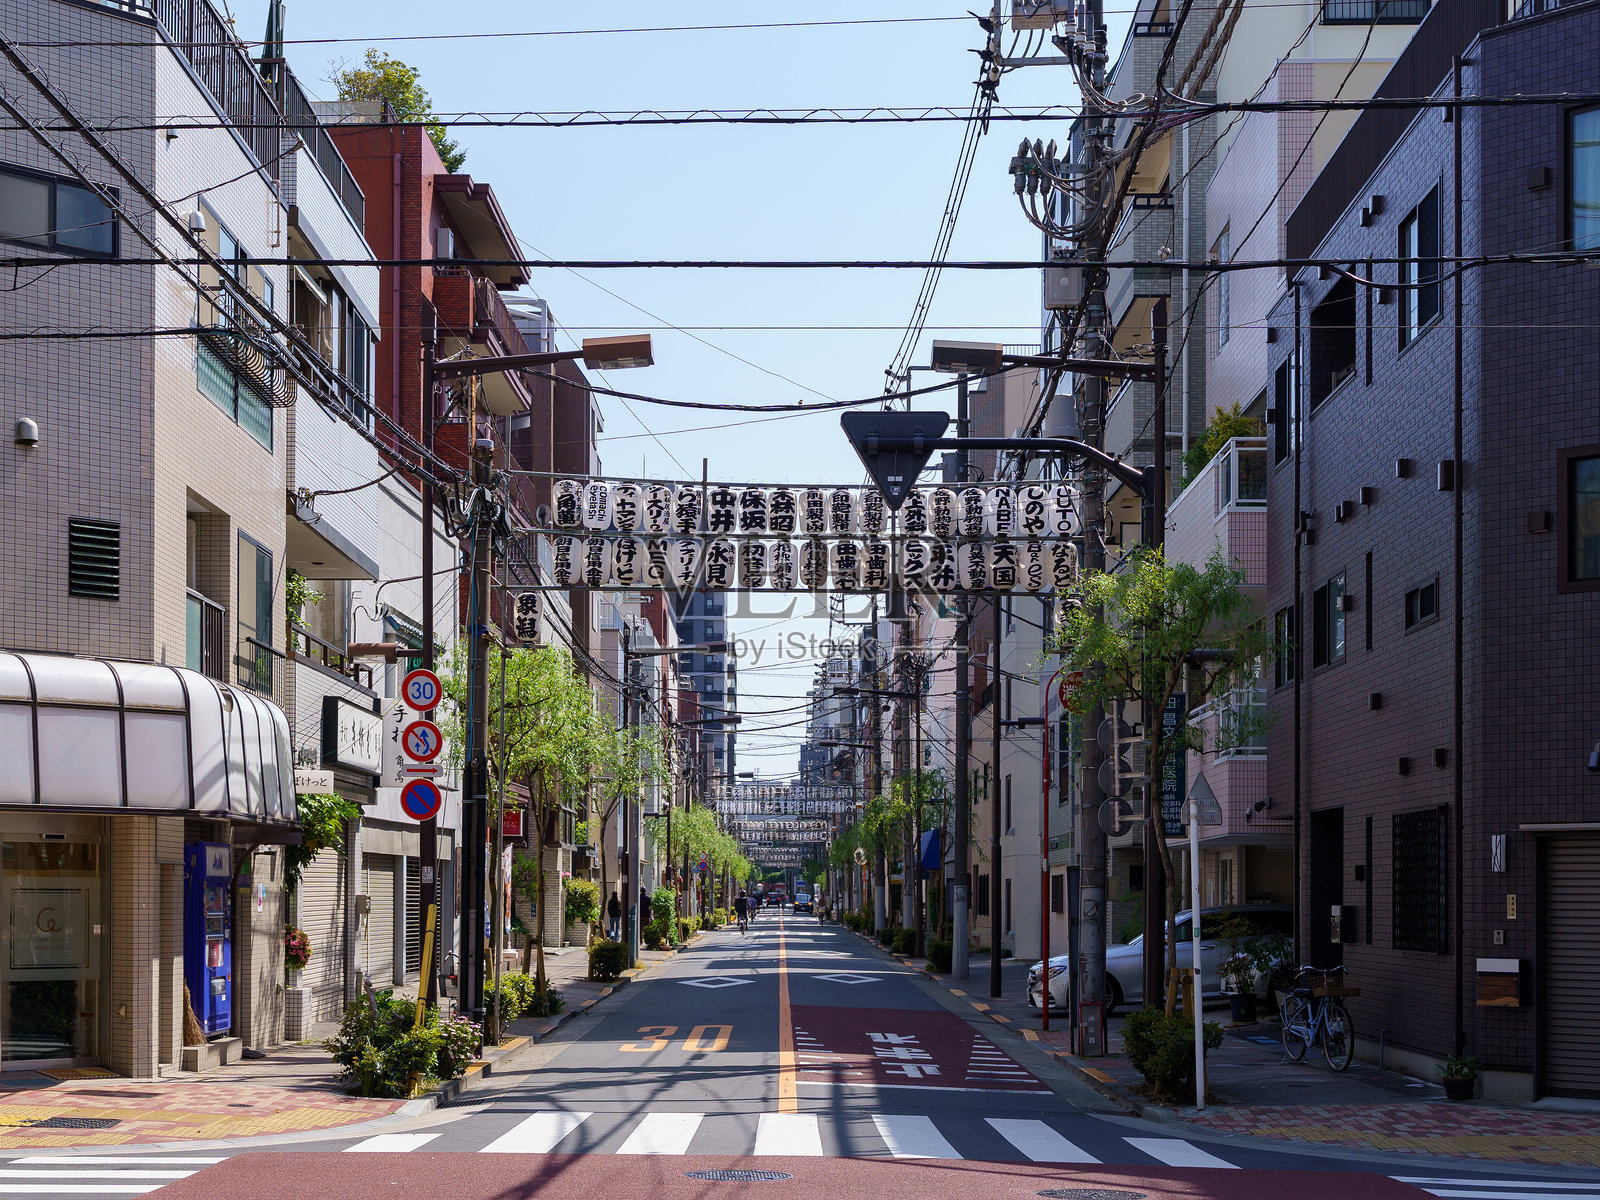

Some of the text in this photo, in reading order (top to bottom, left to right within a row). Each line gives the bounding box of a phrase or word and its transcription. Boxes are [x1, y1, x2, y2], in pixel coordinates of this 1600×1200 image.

[588, 485, 599, 520] eyelash
[597, 486, 608, 522] comachi
[710, 490, 737, 532] 中井
[739, 491, 767, 531] 保坂
[706, 542, 729, 585] 永見
[993, 545, 1017, 586] 天国
[1051, 543, 1071, 587] なると
[411, 681, 434, 700] 30
[618, 1024, 734, 1052] 30
